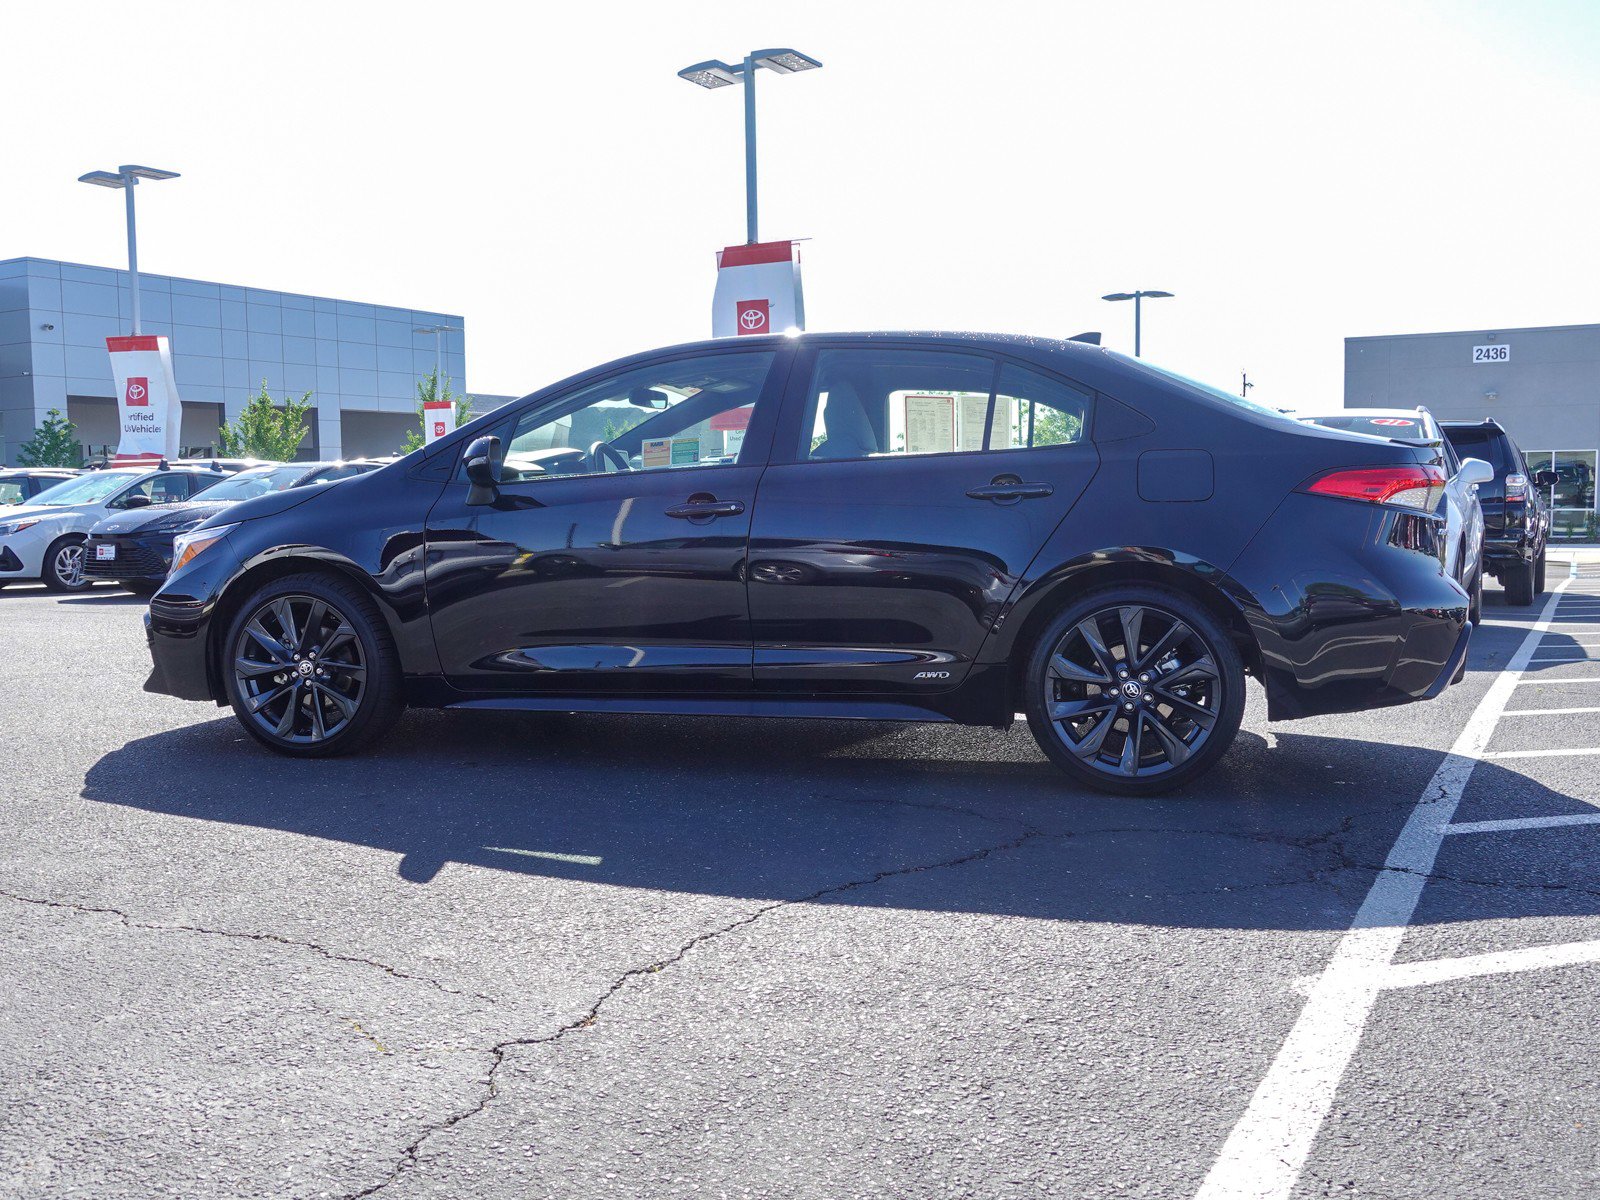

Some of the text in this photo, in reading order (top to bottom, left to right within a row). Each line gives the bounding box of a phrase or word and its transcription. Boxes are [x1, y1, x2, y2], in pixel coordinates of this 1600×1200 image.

[1475, 347, 1507, 360] 2436
[128, 412, 154, 421] rtified
[913, 671, 950, 679] AWD
